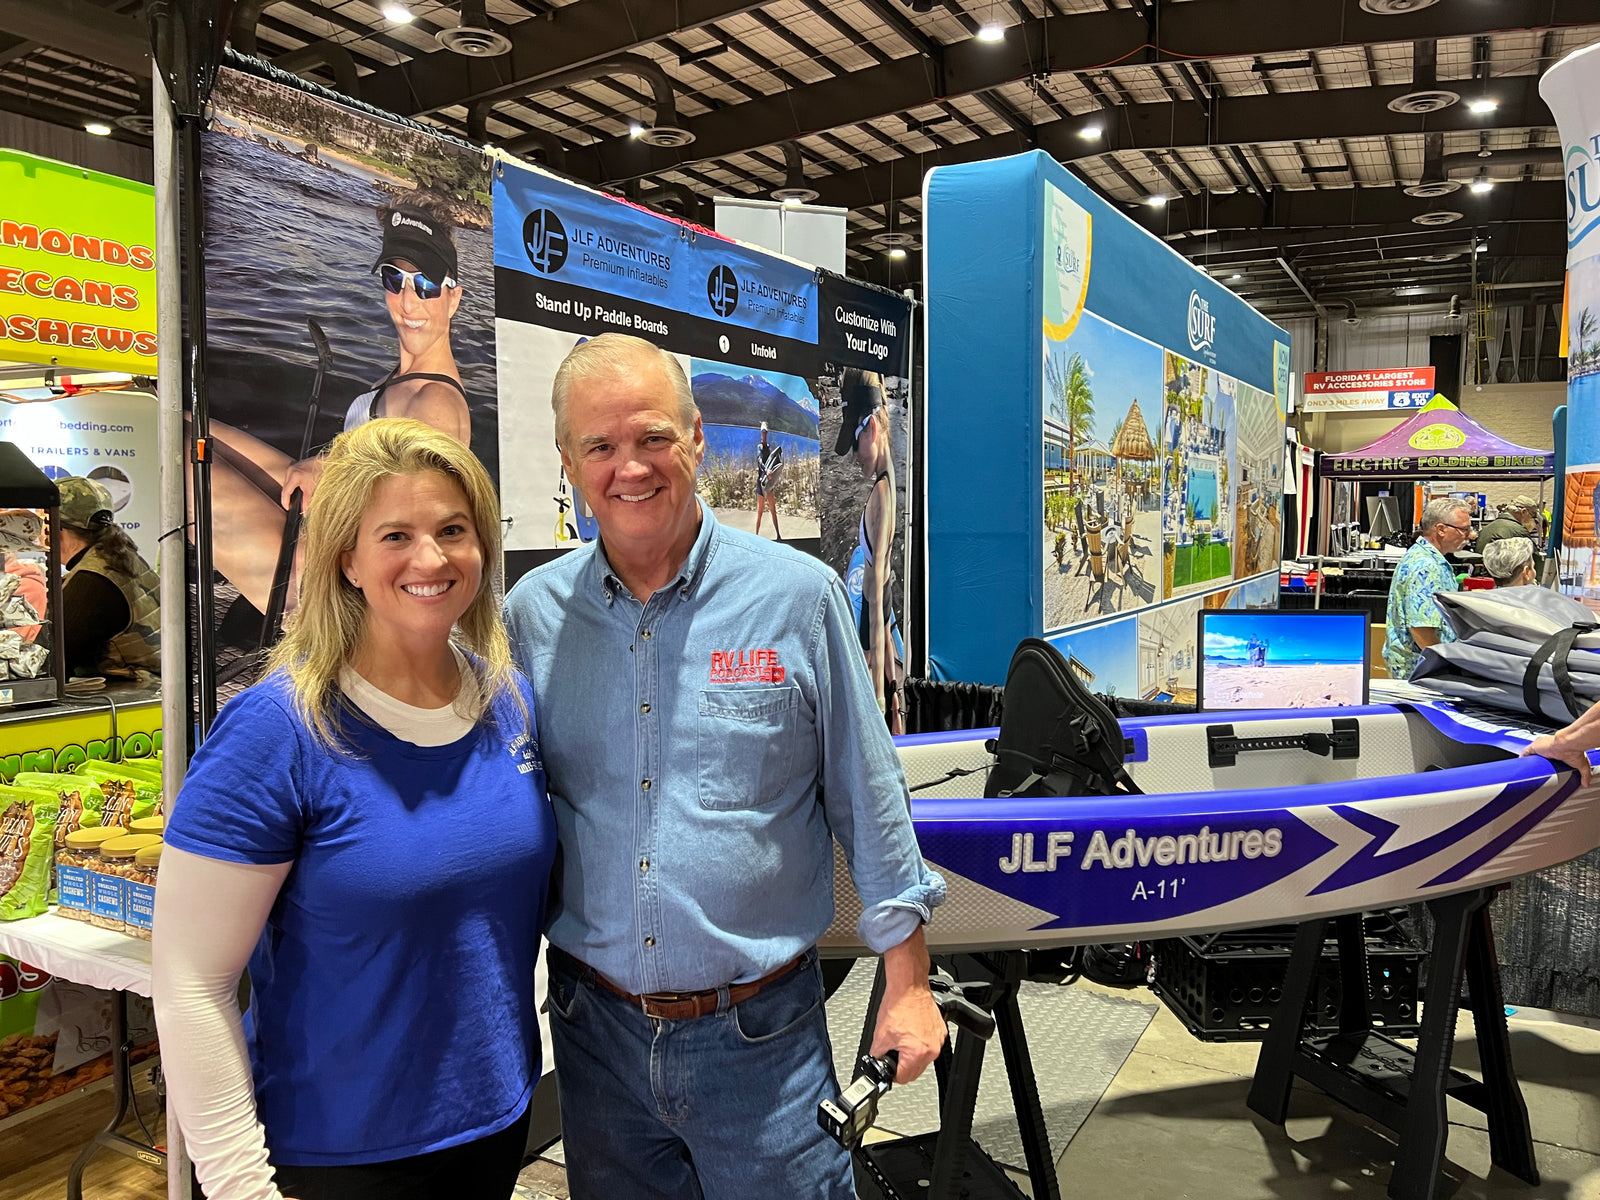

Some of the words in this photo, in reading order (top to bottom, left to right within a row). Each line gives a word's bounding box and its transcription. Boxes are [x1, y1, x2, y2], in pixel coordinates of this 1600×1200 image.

[571, 228, 594, 247] JLF
[597, 236, 671, 271] ADVENTURES
[582, 252, 625, 277] Premium
[627, 265, 669, 289] Inflatables
[740, 279, 756, 295] JLF
[757, 284, 808, 310] ADVENTURES
[535, 292, 571, 315] Stand
[574, 301, 592, 322] Up
[595, 305, 632, 328] Paddle
[634, 314, 669, 336] Boards
[747, 299, 778, 319] Premium
[835, 305, 879, 332] Customize
[880, 318, 897, 337] With
[1192, 305, 1216, 344] SURF
[0, 315, 158, 356] SHEWS
[845, 331, 867, 353] Your
[868, 337, 889, 360] Logo
[751, 342, 777, 360] Unfold
[1313, 382, 1326, 390] RV
[1396, 378, 1426, 387] STORE
[1325, 373, 1371, 383] FLORIDA'S
[1373, 371, 1414, 381] LARGEST
[31, 446, 89, 456] TRAILERS
[93, 448, 101, 456] &
[104, 448, 136, 457] VANS
[1333, 457, 1410, 472] ELECTRIC
[1418, 456, 1488, 468] FOLDING
[1494, 455, 1545, 467] BIKES
[120, 522, 141, 530] TOP
[711, 651, 735, 669] RV
[738, 649, 778, 667] LIFE
[710, 666, 763, 679] PODCAST
[998, 831, 1075, 875] JLF
[1080, 824, 1283, 871] Adventures
[63, 880, 84, 888] WHOLE
[98, 889, 118, 897] WHOLE
[133, 897, 153, 906] WHOLE
